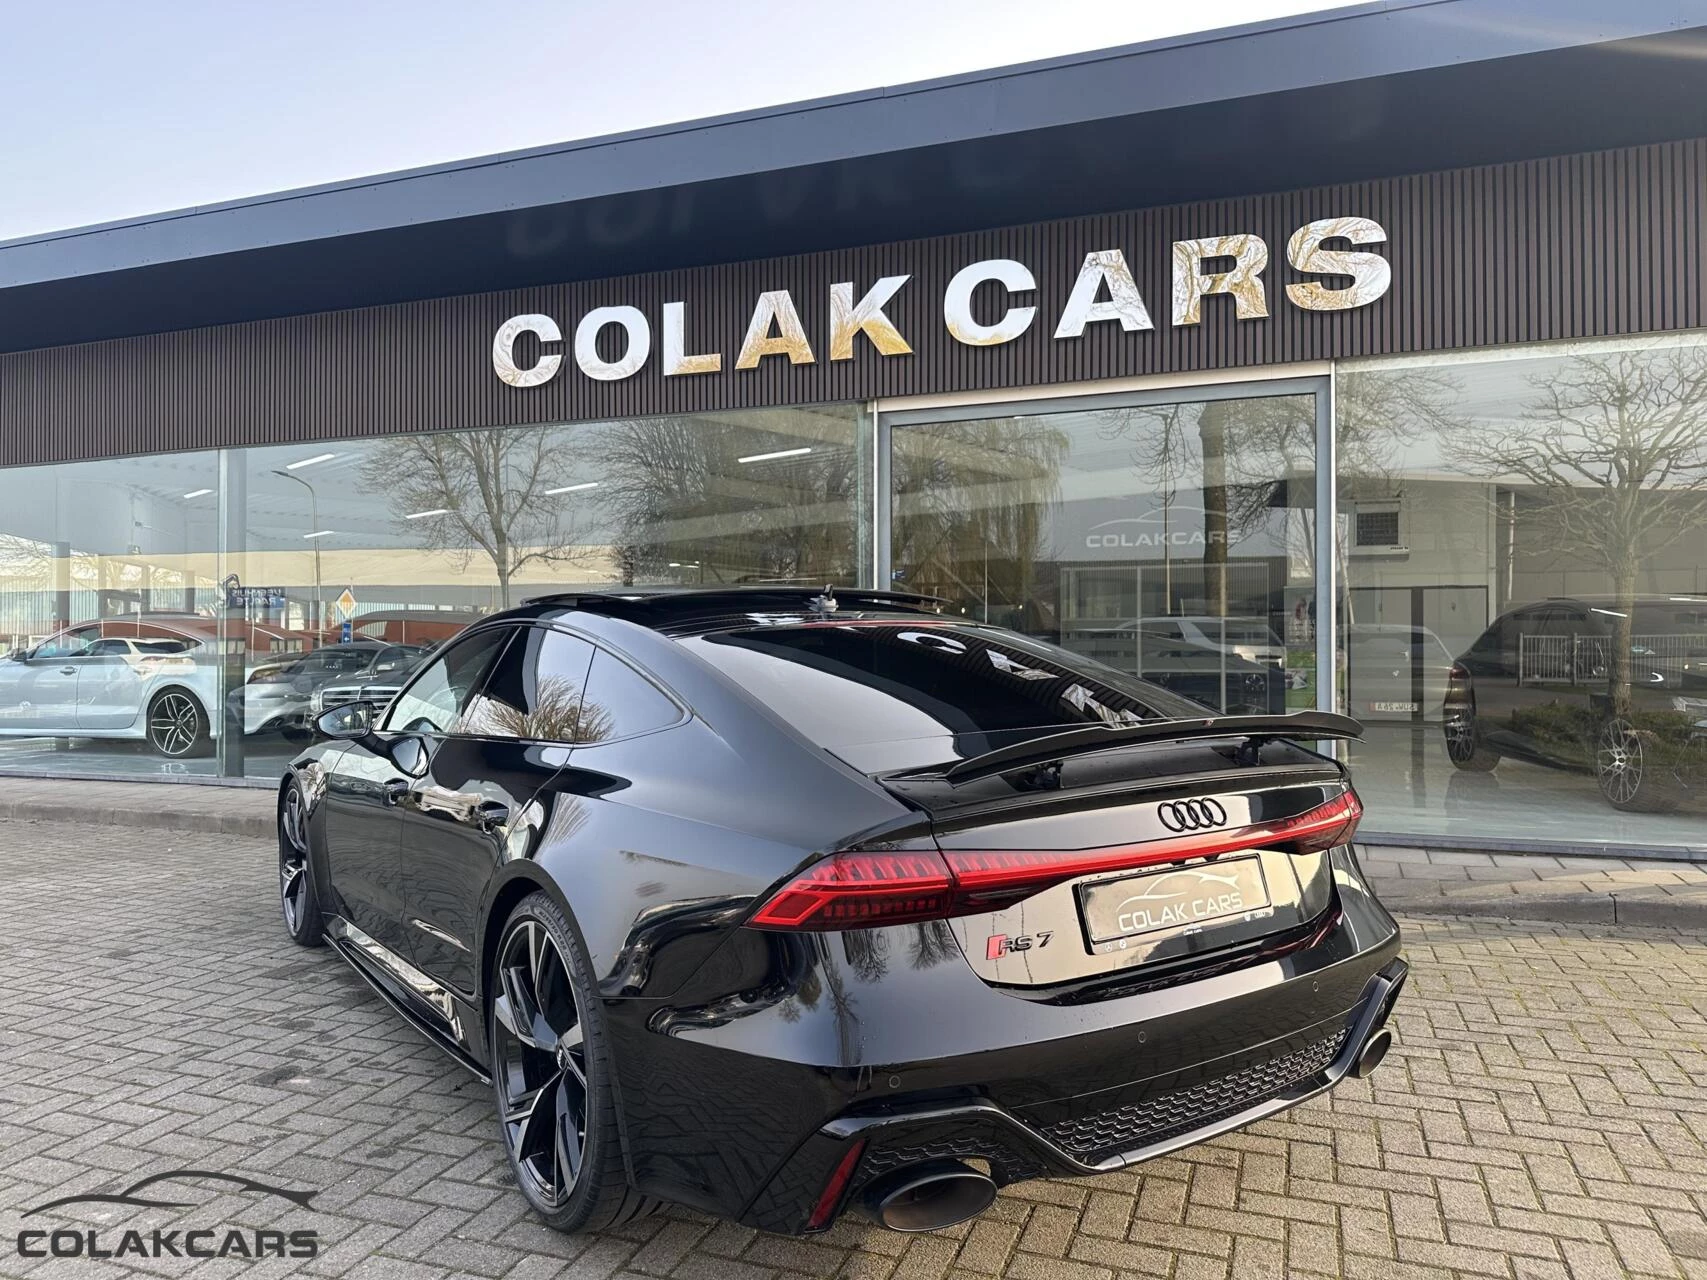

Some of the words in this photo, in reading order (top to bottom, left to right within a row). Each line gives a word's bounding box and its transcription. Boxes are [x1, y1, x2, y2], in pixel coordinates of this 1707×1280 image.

[492, 273, 915, 388] COLAK
[944, 216, 1392, 348] CARS
[1086, 529, 1241, 548] COLAKCARS
[1118, 902, 1189, 932] COLAK
[1192, 892, 1242, 917] CARS
